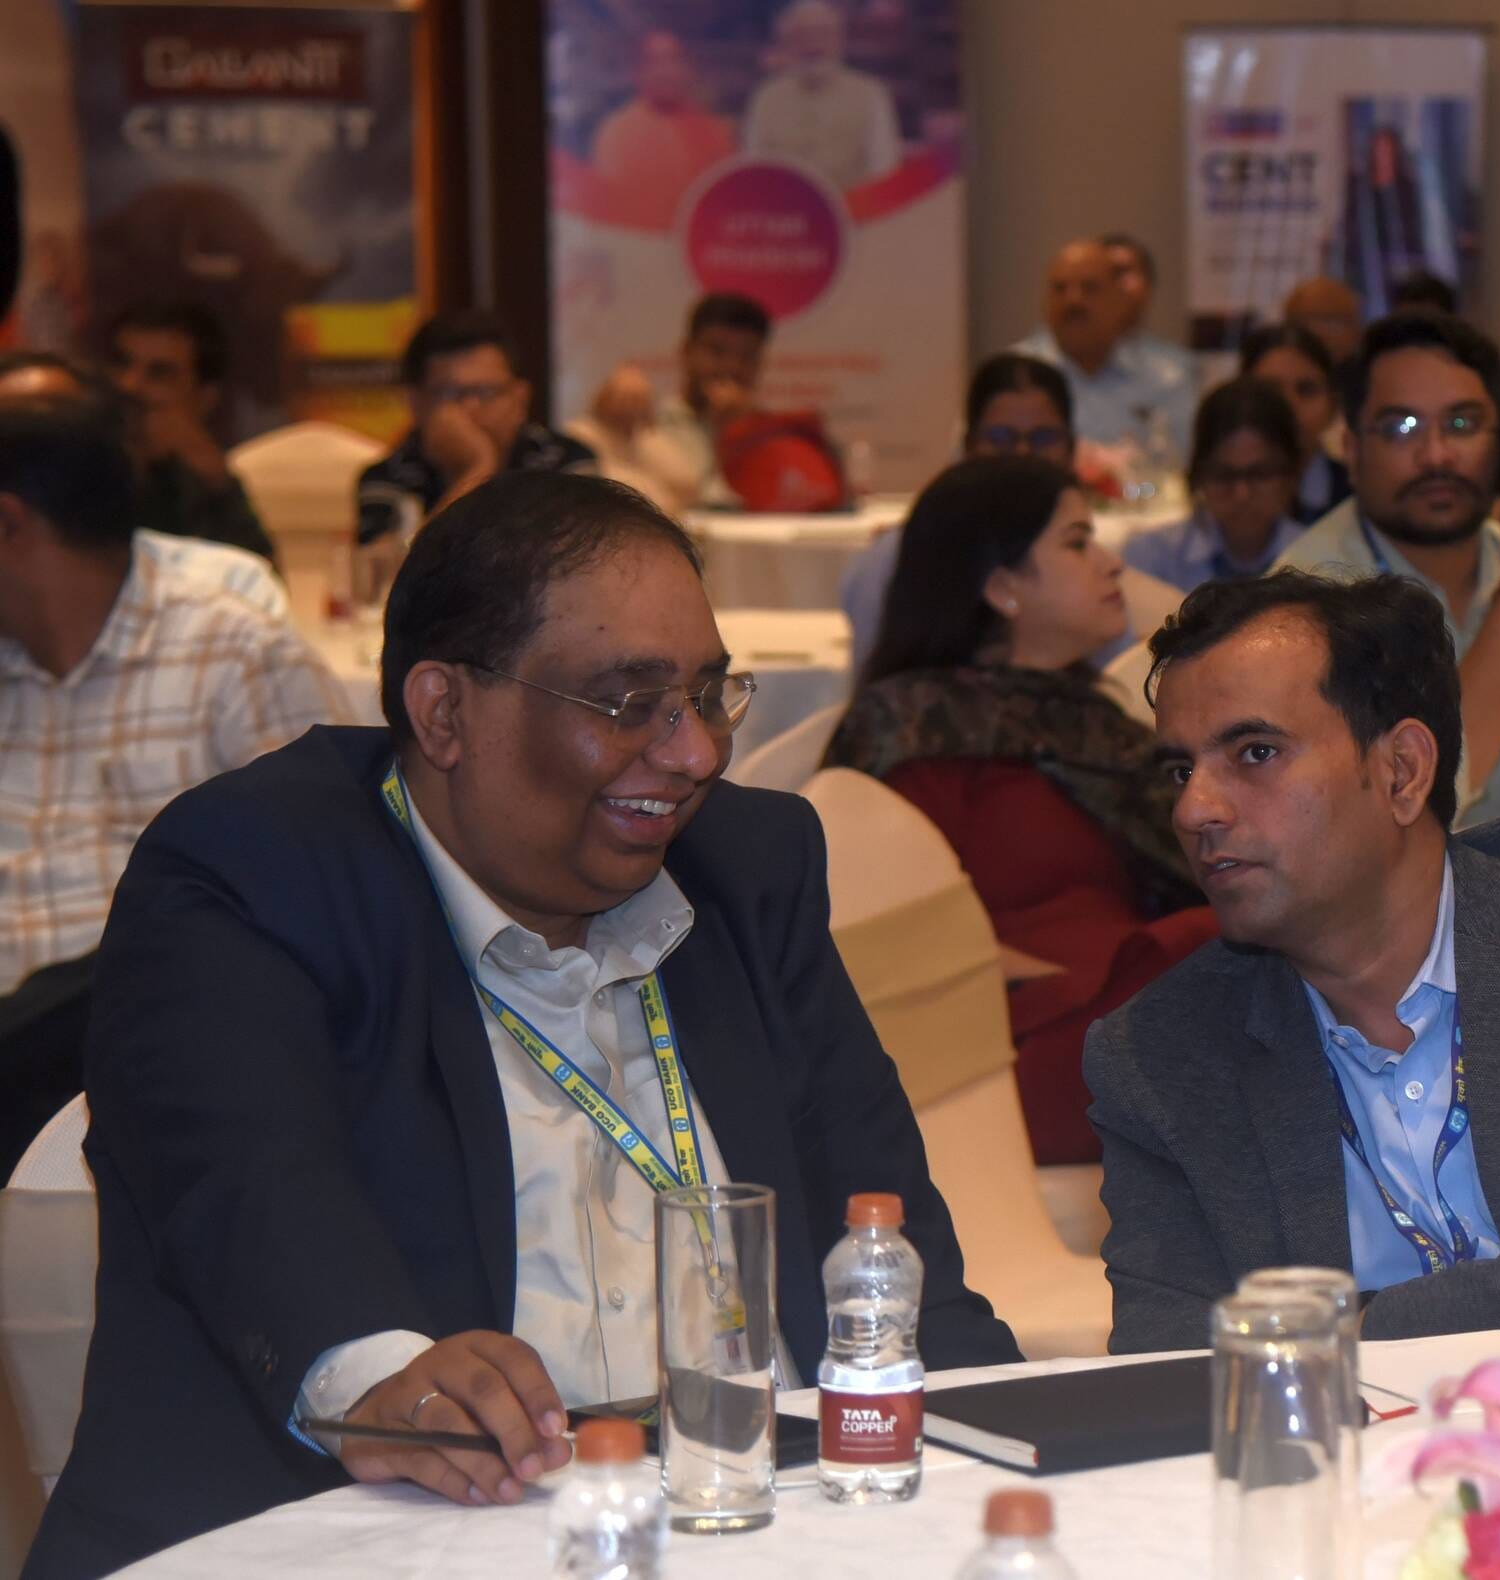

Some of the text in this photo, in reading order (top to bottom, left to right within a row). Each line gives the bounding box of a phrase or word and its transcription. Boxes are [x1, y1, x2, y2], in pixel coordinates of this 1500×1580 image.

[120, 104, 375, 151] CEMENT
[1203, 152, 1319, 192] CENT
[659, 1056, 678, 1110] UCO BANK
[570, 1085, 617, 1133] UCO BANK
[841, 1408, 882, 1420] TATA
[841, 1420, 895, 1434] COPPER
